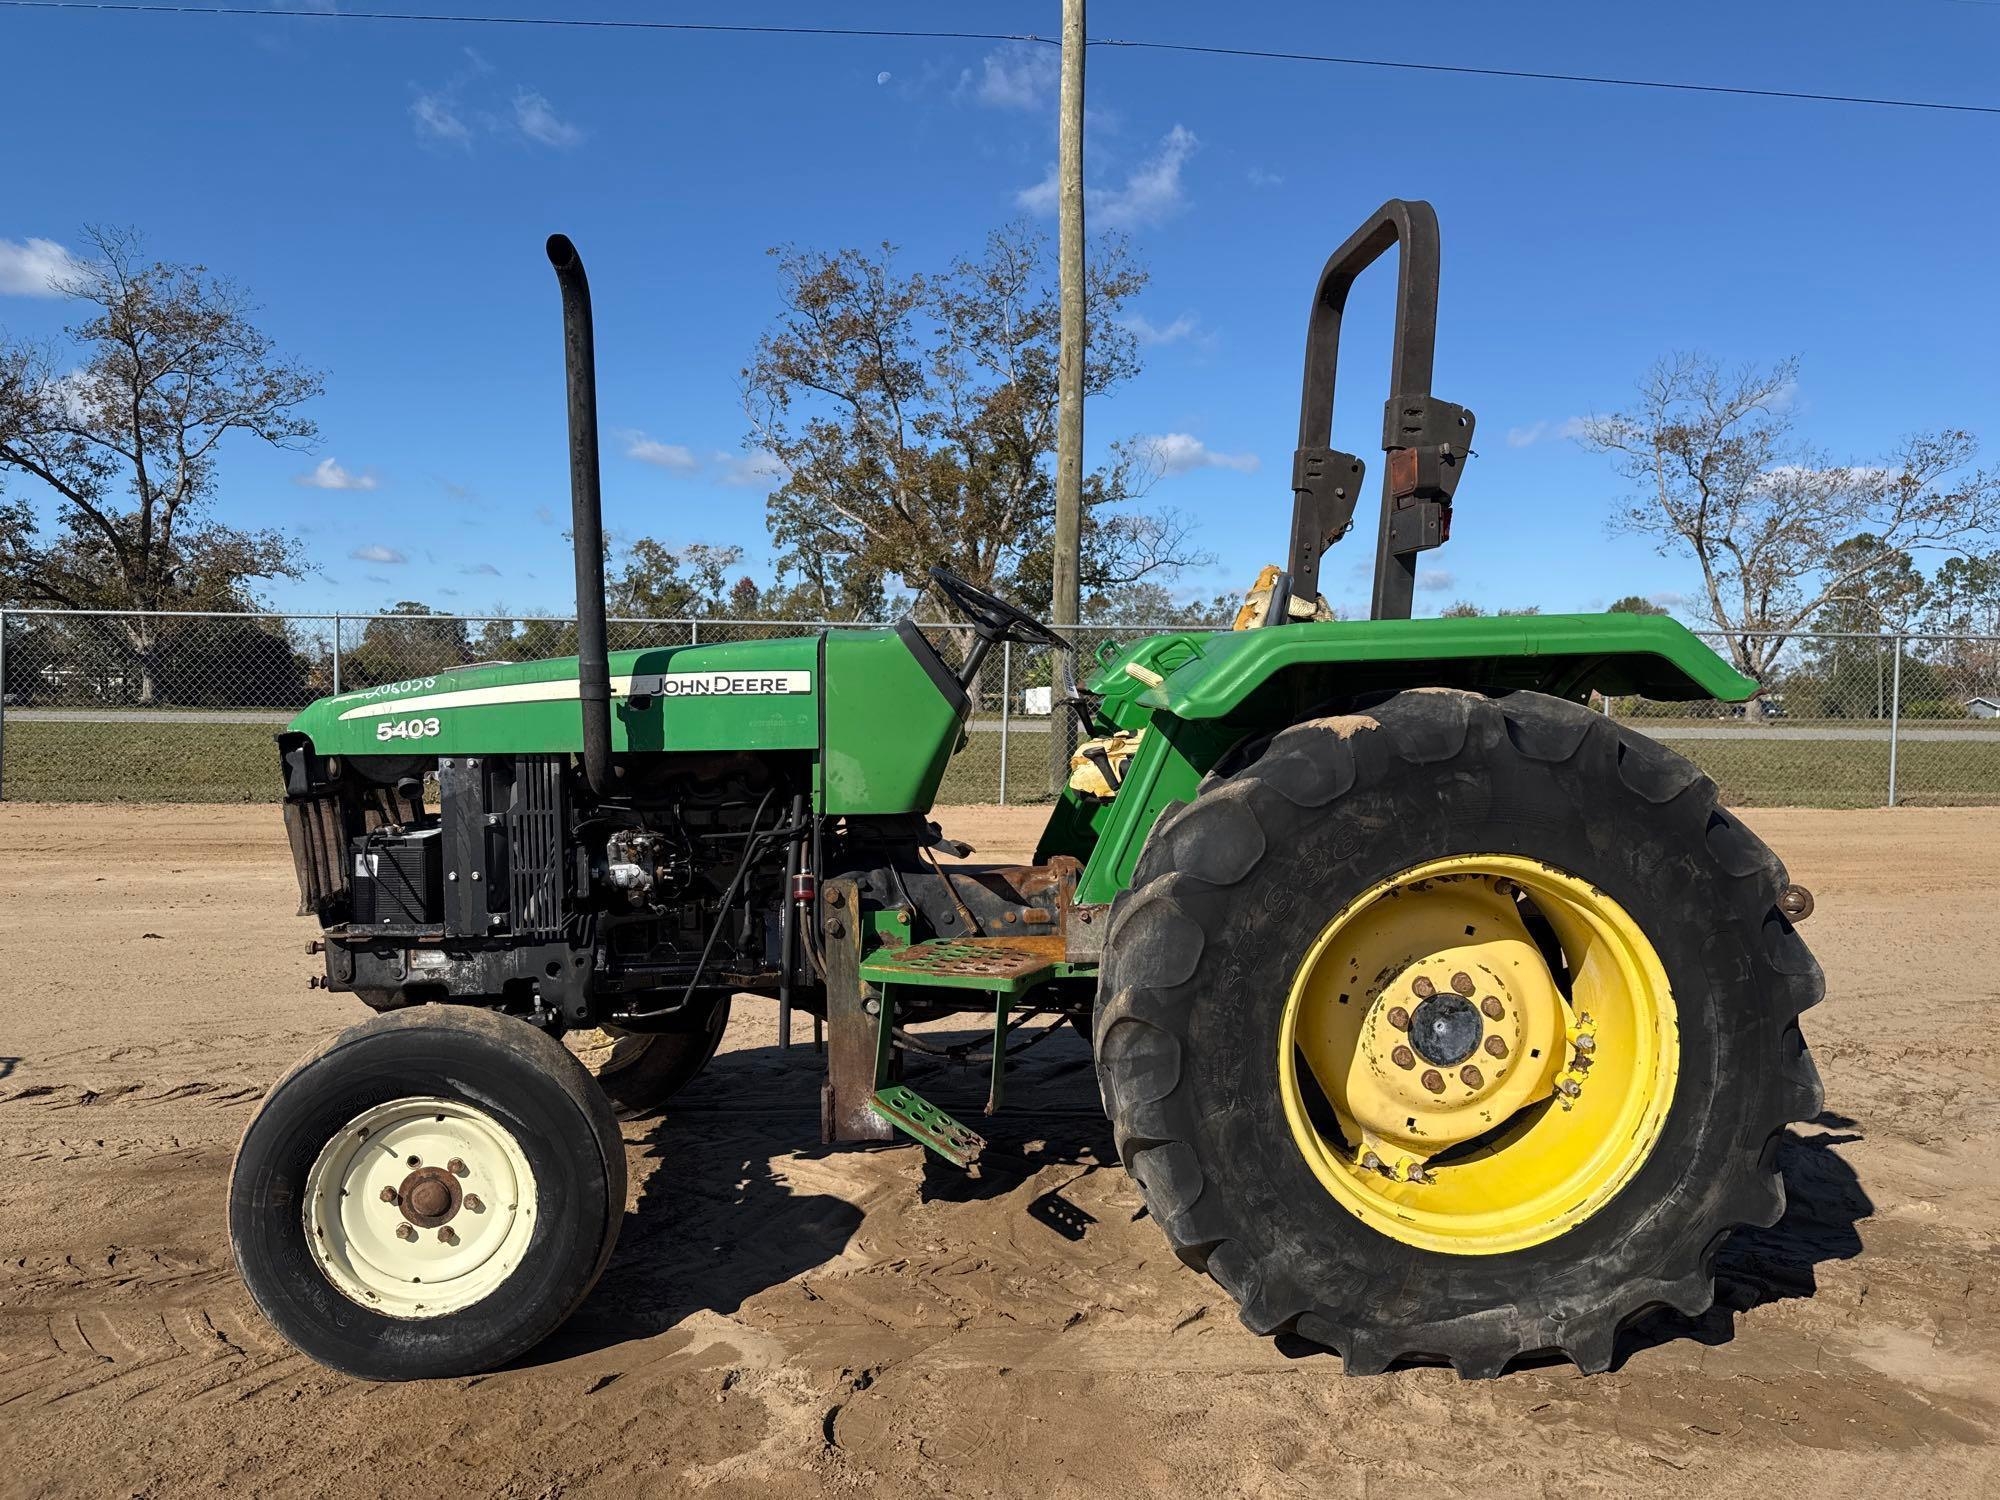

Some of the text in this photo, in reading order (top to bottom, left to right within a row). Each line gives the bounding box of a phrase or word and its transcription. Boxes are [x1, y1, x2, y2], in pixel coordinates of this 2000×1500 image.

[651, 676, 788, 695] JOHN DEERE
[376, 717, 441, 741] 5403
